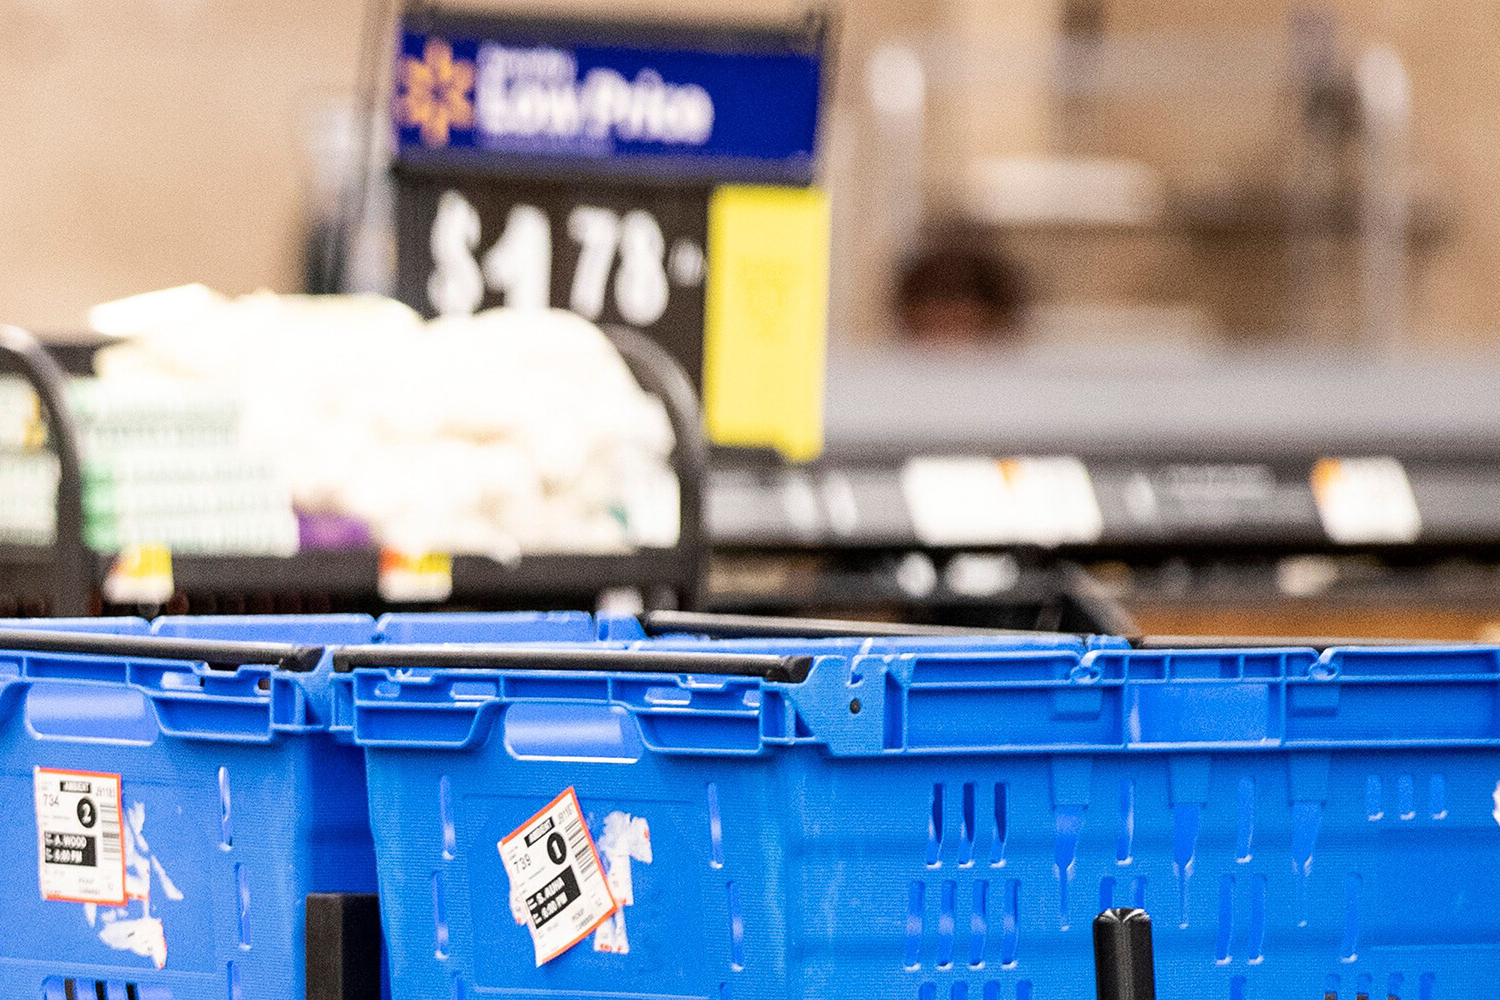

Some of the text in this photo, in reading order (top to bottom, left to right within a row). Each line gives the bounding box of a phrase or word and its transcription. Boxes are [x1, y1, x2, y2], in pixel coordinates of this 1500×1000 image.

[81, 803, 92, 823] 2
[551, 839, 563, 861] 1
[513, 853, 533, 875] 739
